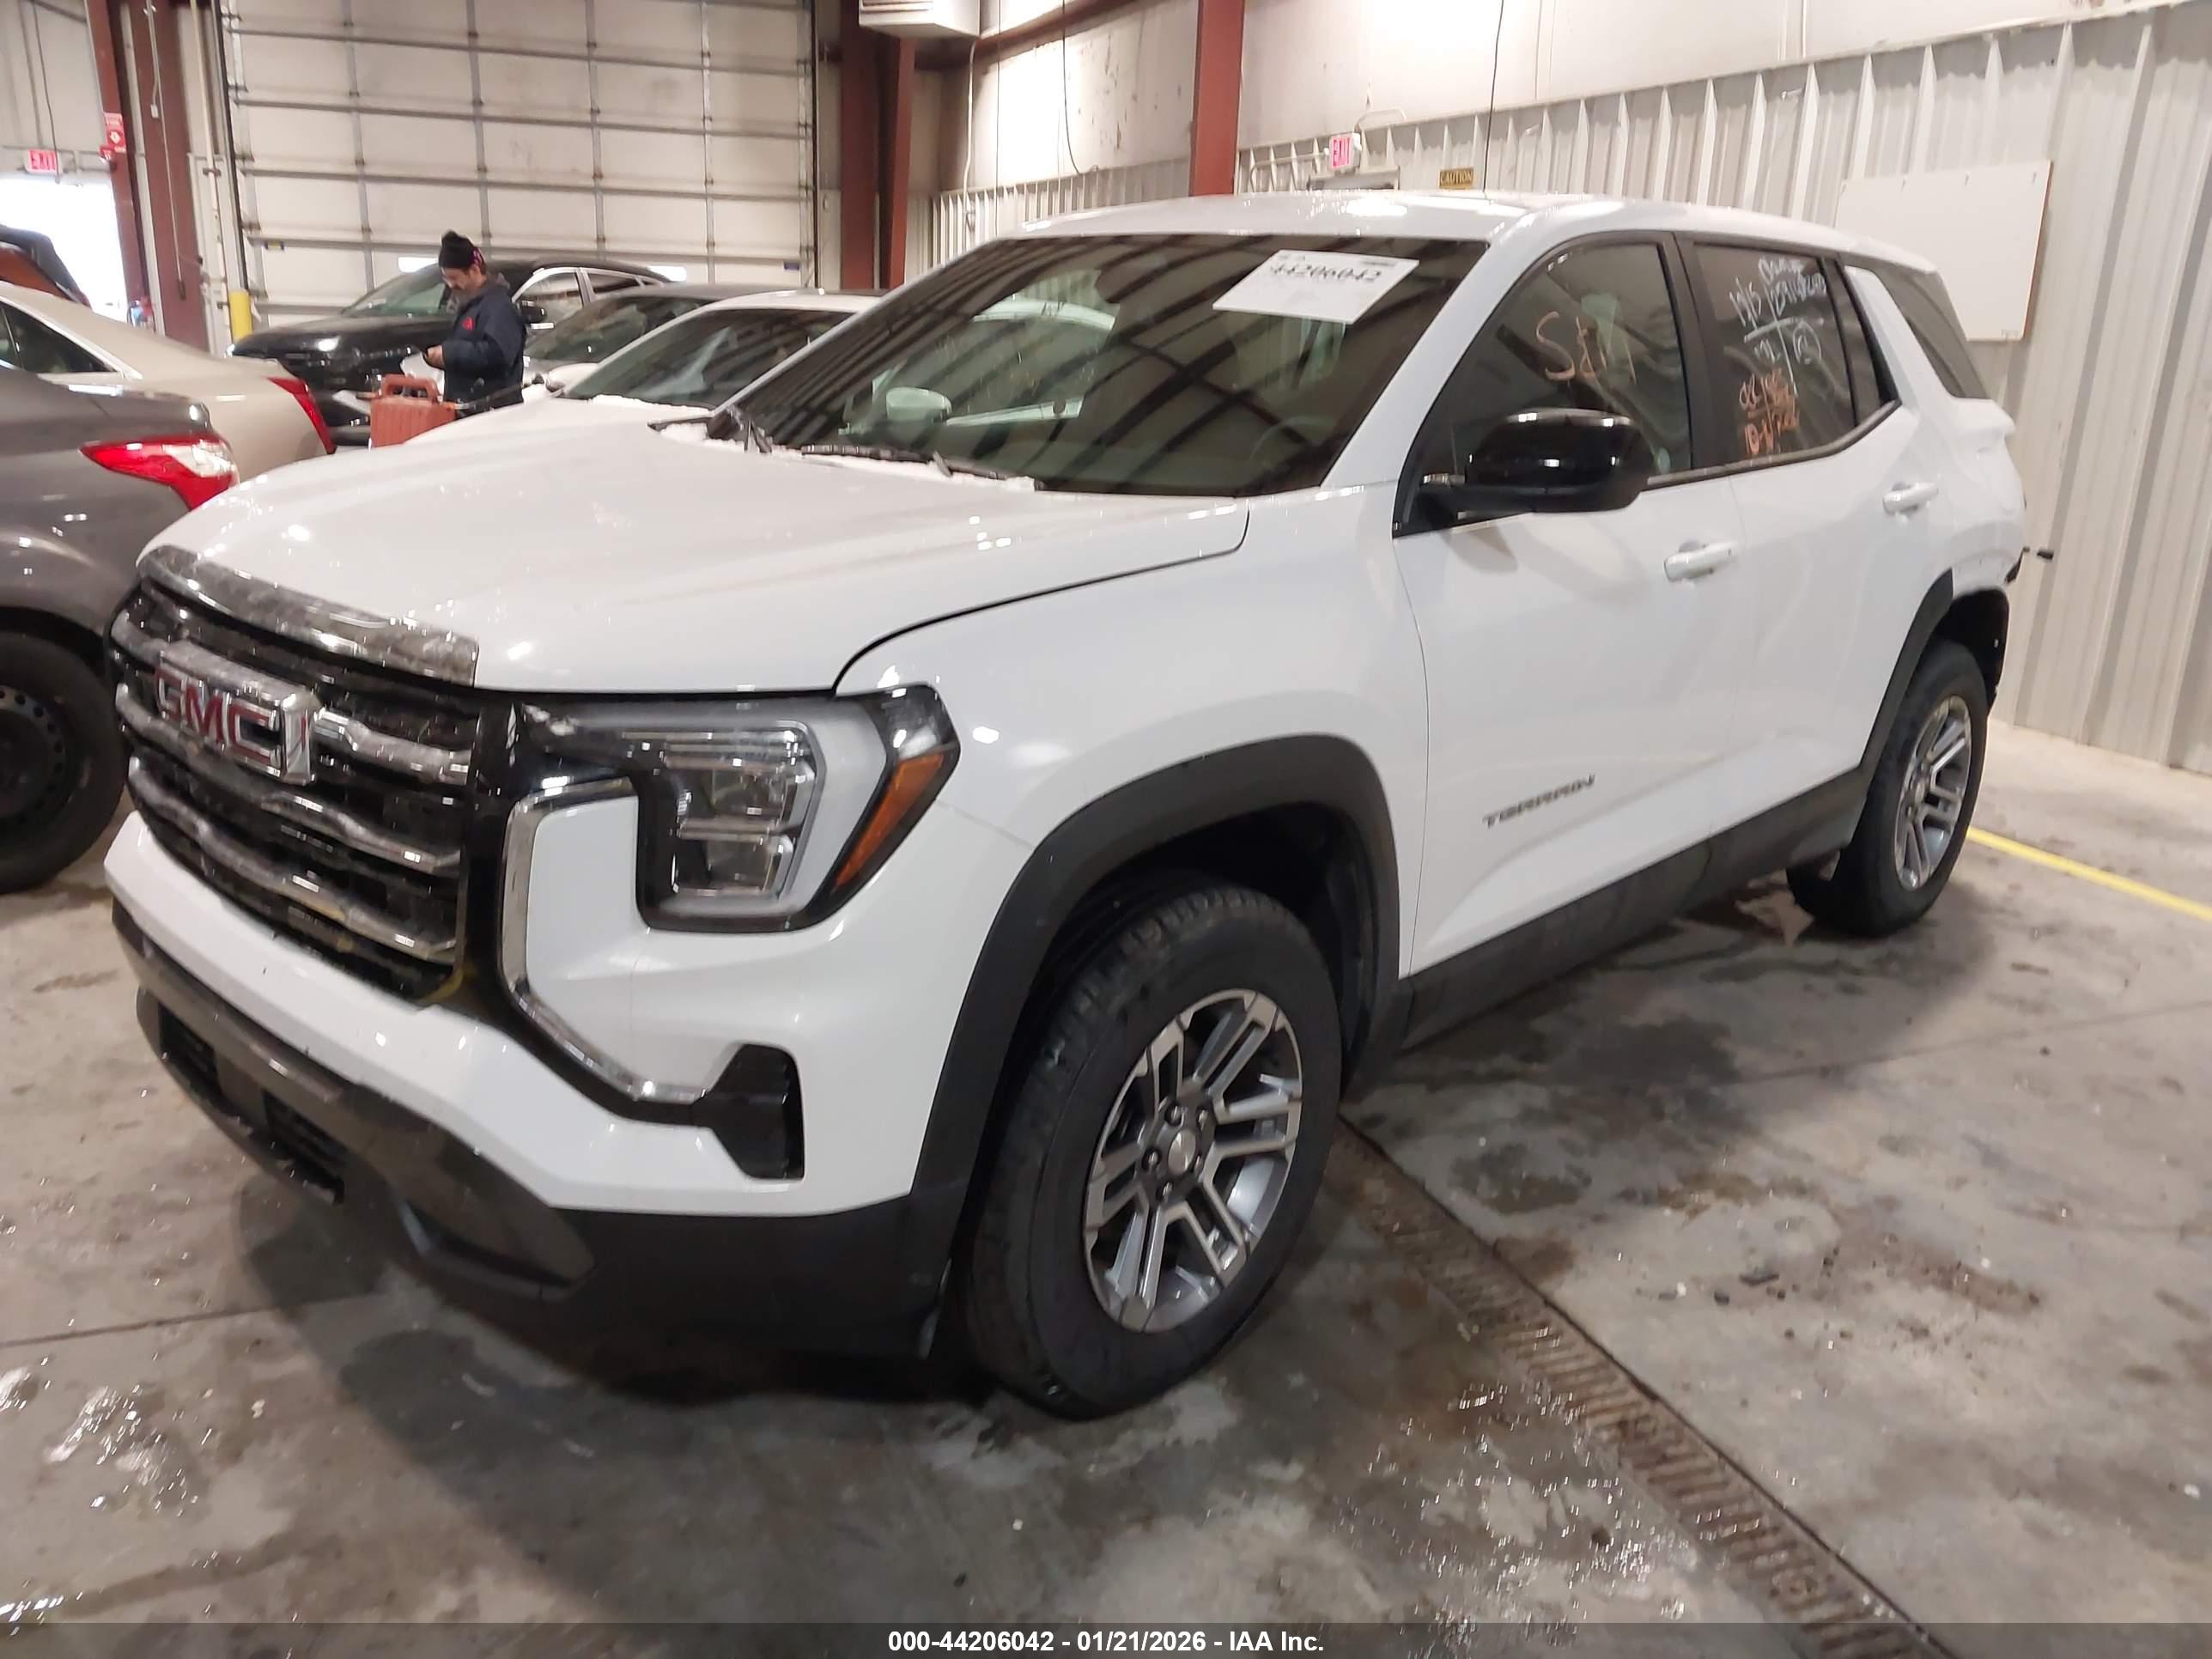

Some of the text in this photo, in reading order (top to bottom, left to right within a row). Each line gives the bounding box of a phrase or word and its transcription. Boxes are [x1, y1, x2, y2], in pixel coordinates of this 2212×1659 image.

[1333, 137, 1352, 168] EXIT
[1440, 172, 1473, 185] CAUTION
[155, 665, 282, 777] GMC
[1482, 773, 1595, 829] TERRAIN
